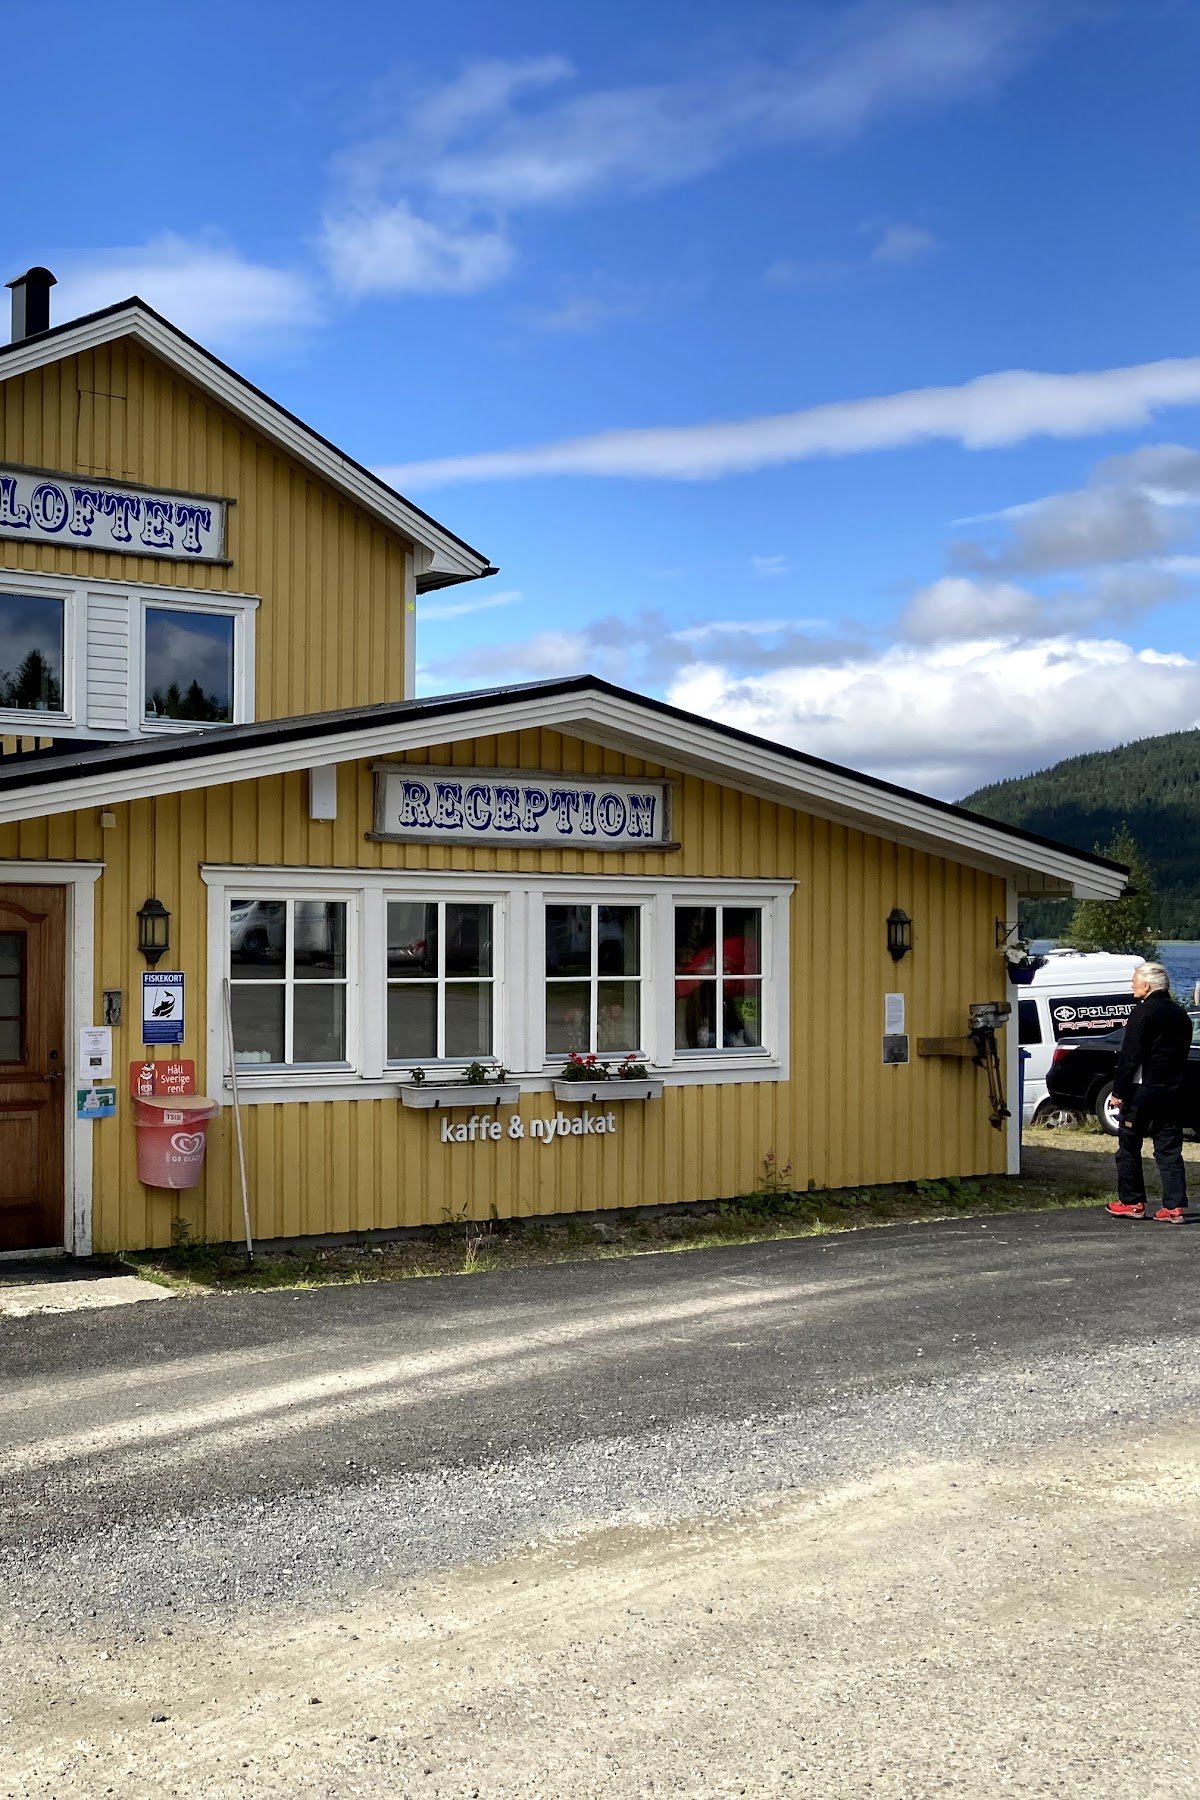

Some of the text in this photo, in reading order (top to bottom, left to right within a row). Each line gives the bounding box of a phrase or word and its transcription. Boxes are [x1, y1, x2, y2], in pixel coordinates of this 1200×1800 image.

[398, 780, 656, 838] RECEPTION
[144, 974, 183, 983] FISKEKORT
[1059, 1018, 1128, 1031] RACIN
[167, 1064, 184, 1074] Håll
[160, 1075, 191, 1085] Sverige
[167, 1085, 185, 1093] rent
[440, 1110, 616, 1144] kaffe & nybakat
